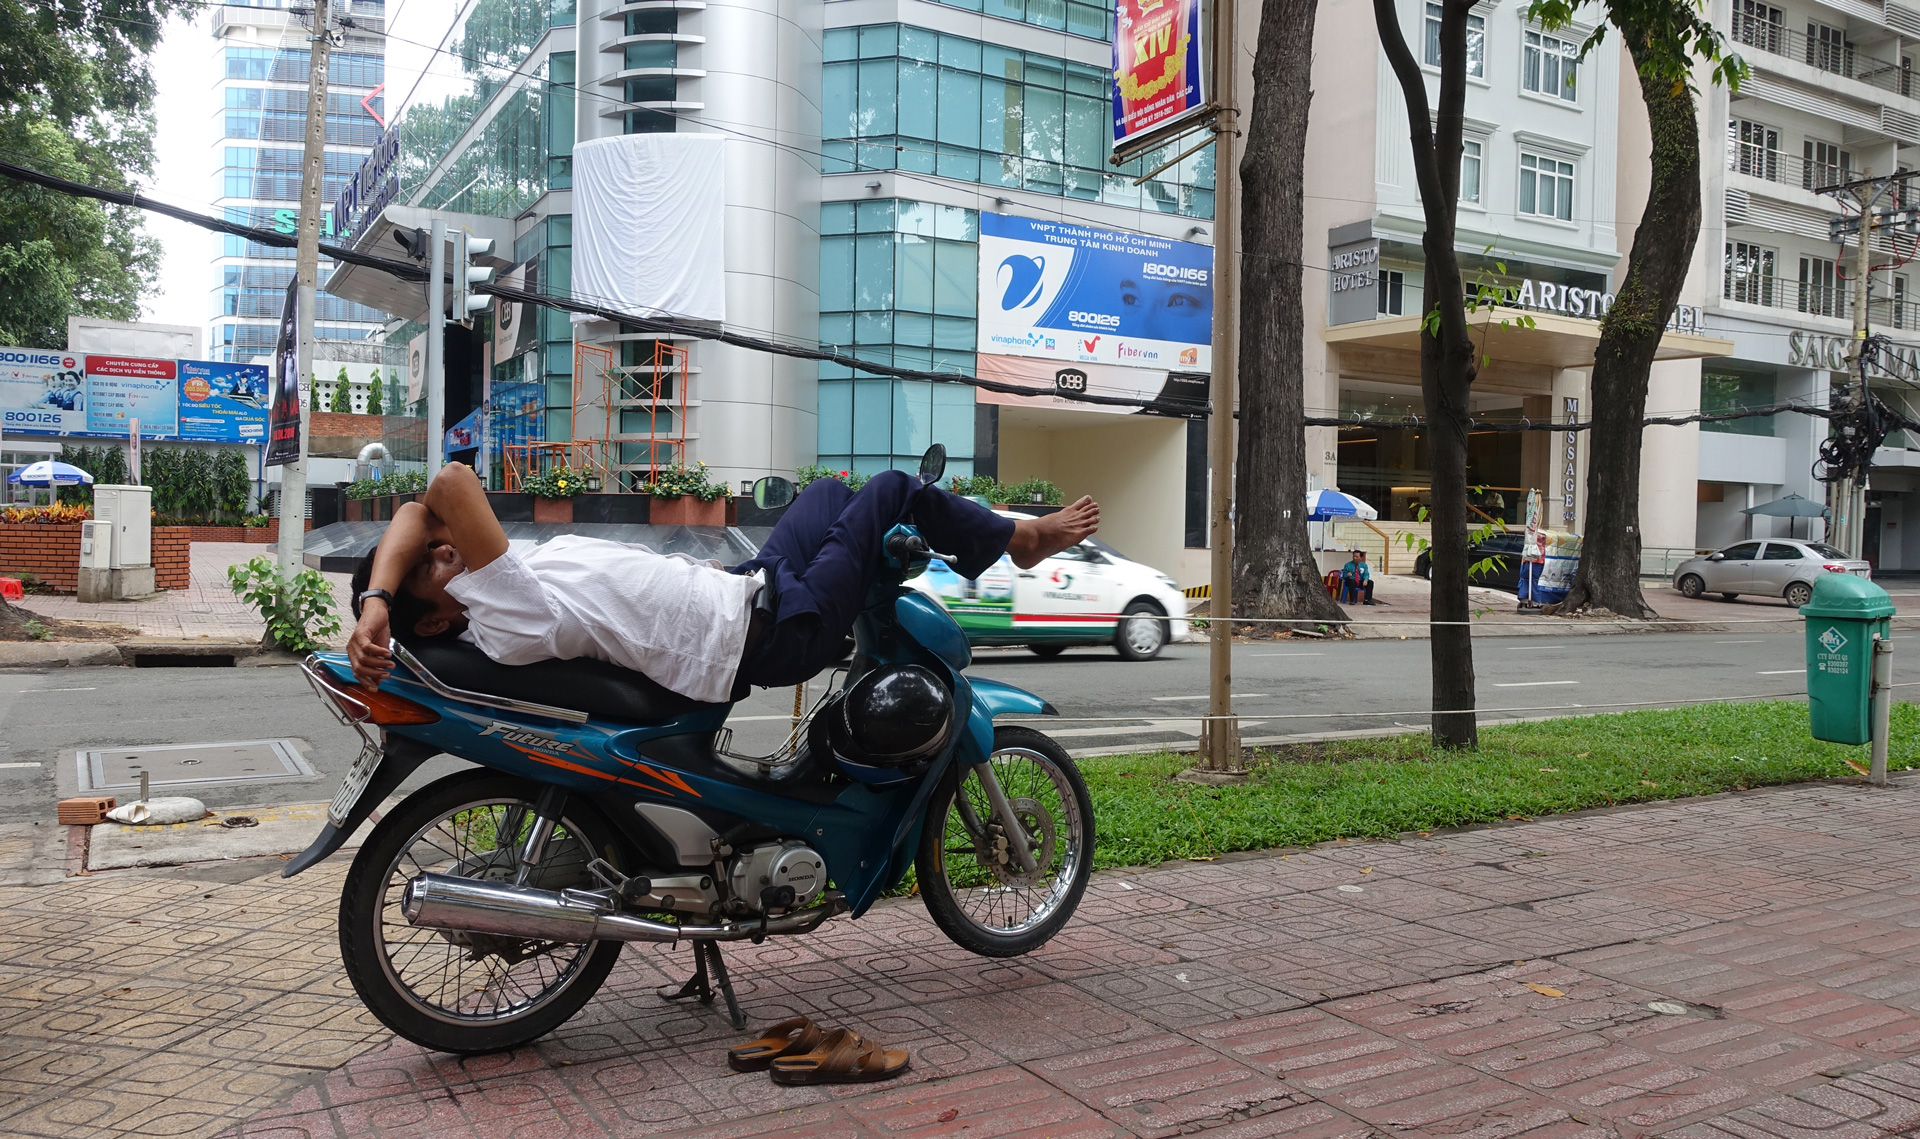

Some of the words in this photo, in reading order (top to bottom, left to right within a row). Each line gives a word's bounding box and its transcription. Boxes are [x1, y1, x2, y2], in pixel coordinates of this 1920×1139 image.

[1133, 23, 1172, 68] XIV
[1030, 222, 1056, 233] VNPT
[1059, 226, 1091, 238] THÀNH
[1094, 232, 1113, 242] PHỐ
[1116, 234, 1129, 244] HỒ
[1132, 236, 1146, 247] CHÍ
[1149, 240, 1172, 250] MINH
[1044, 234, 1078, 246] TRUNG
[1080, 239, 1100, 249] TÂM
[1102, 243, 1124, 252] KINH
[1127, 247, 1158, 257] DOANH
[1332, 247, 1377, 270] ARISTO
[1333, 270, 1372, 292] HOTEL
[1068, 311, 1120, 326] 800126
[991, 335, 1032, 346] vinaphone
[5, 412, 62, 423] 800126
[1325, 451, 1336, 461] 3A
[1565, 399, 1578, 507] MASSAGE
[533, 747, 559, 756] HONDA
